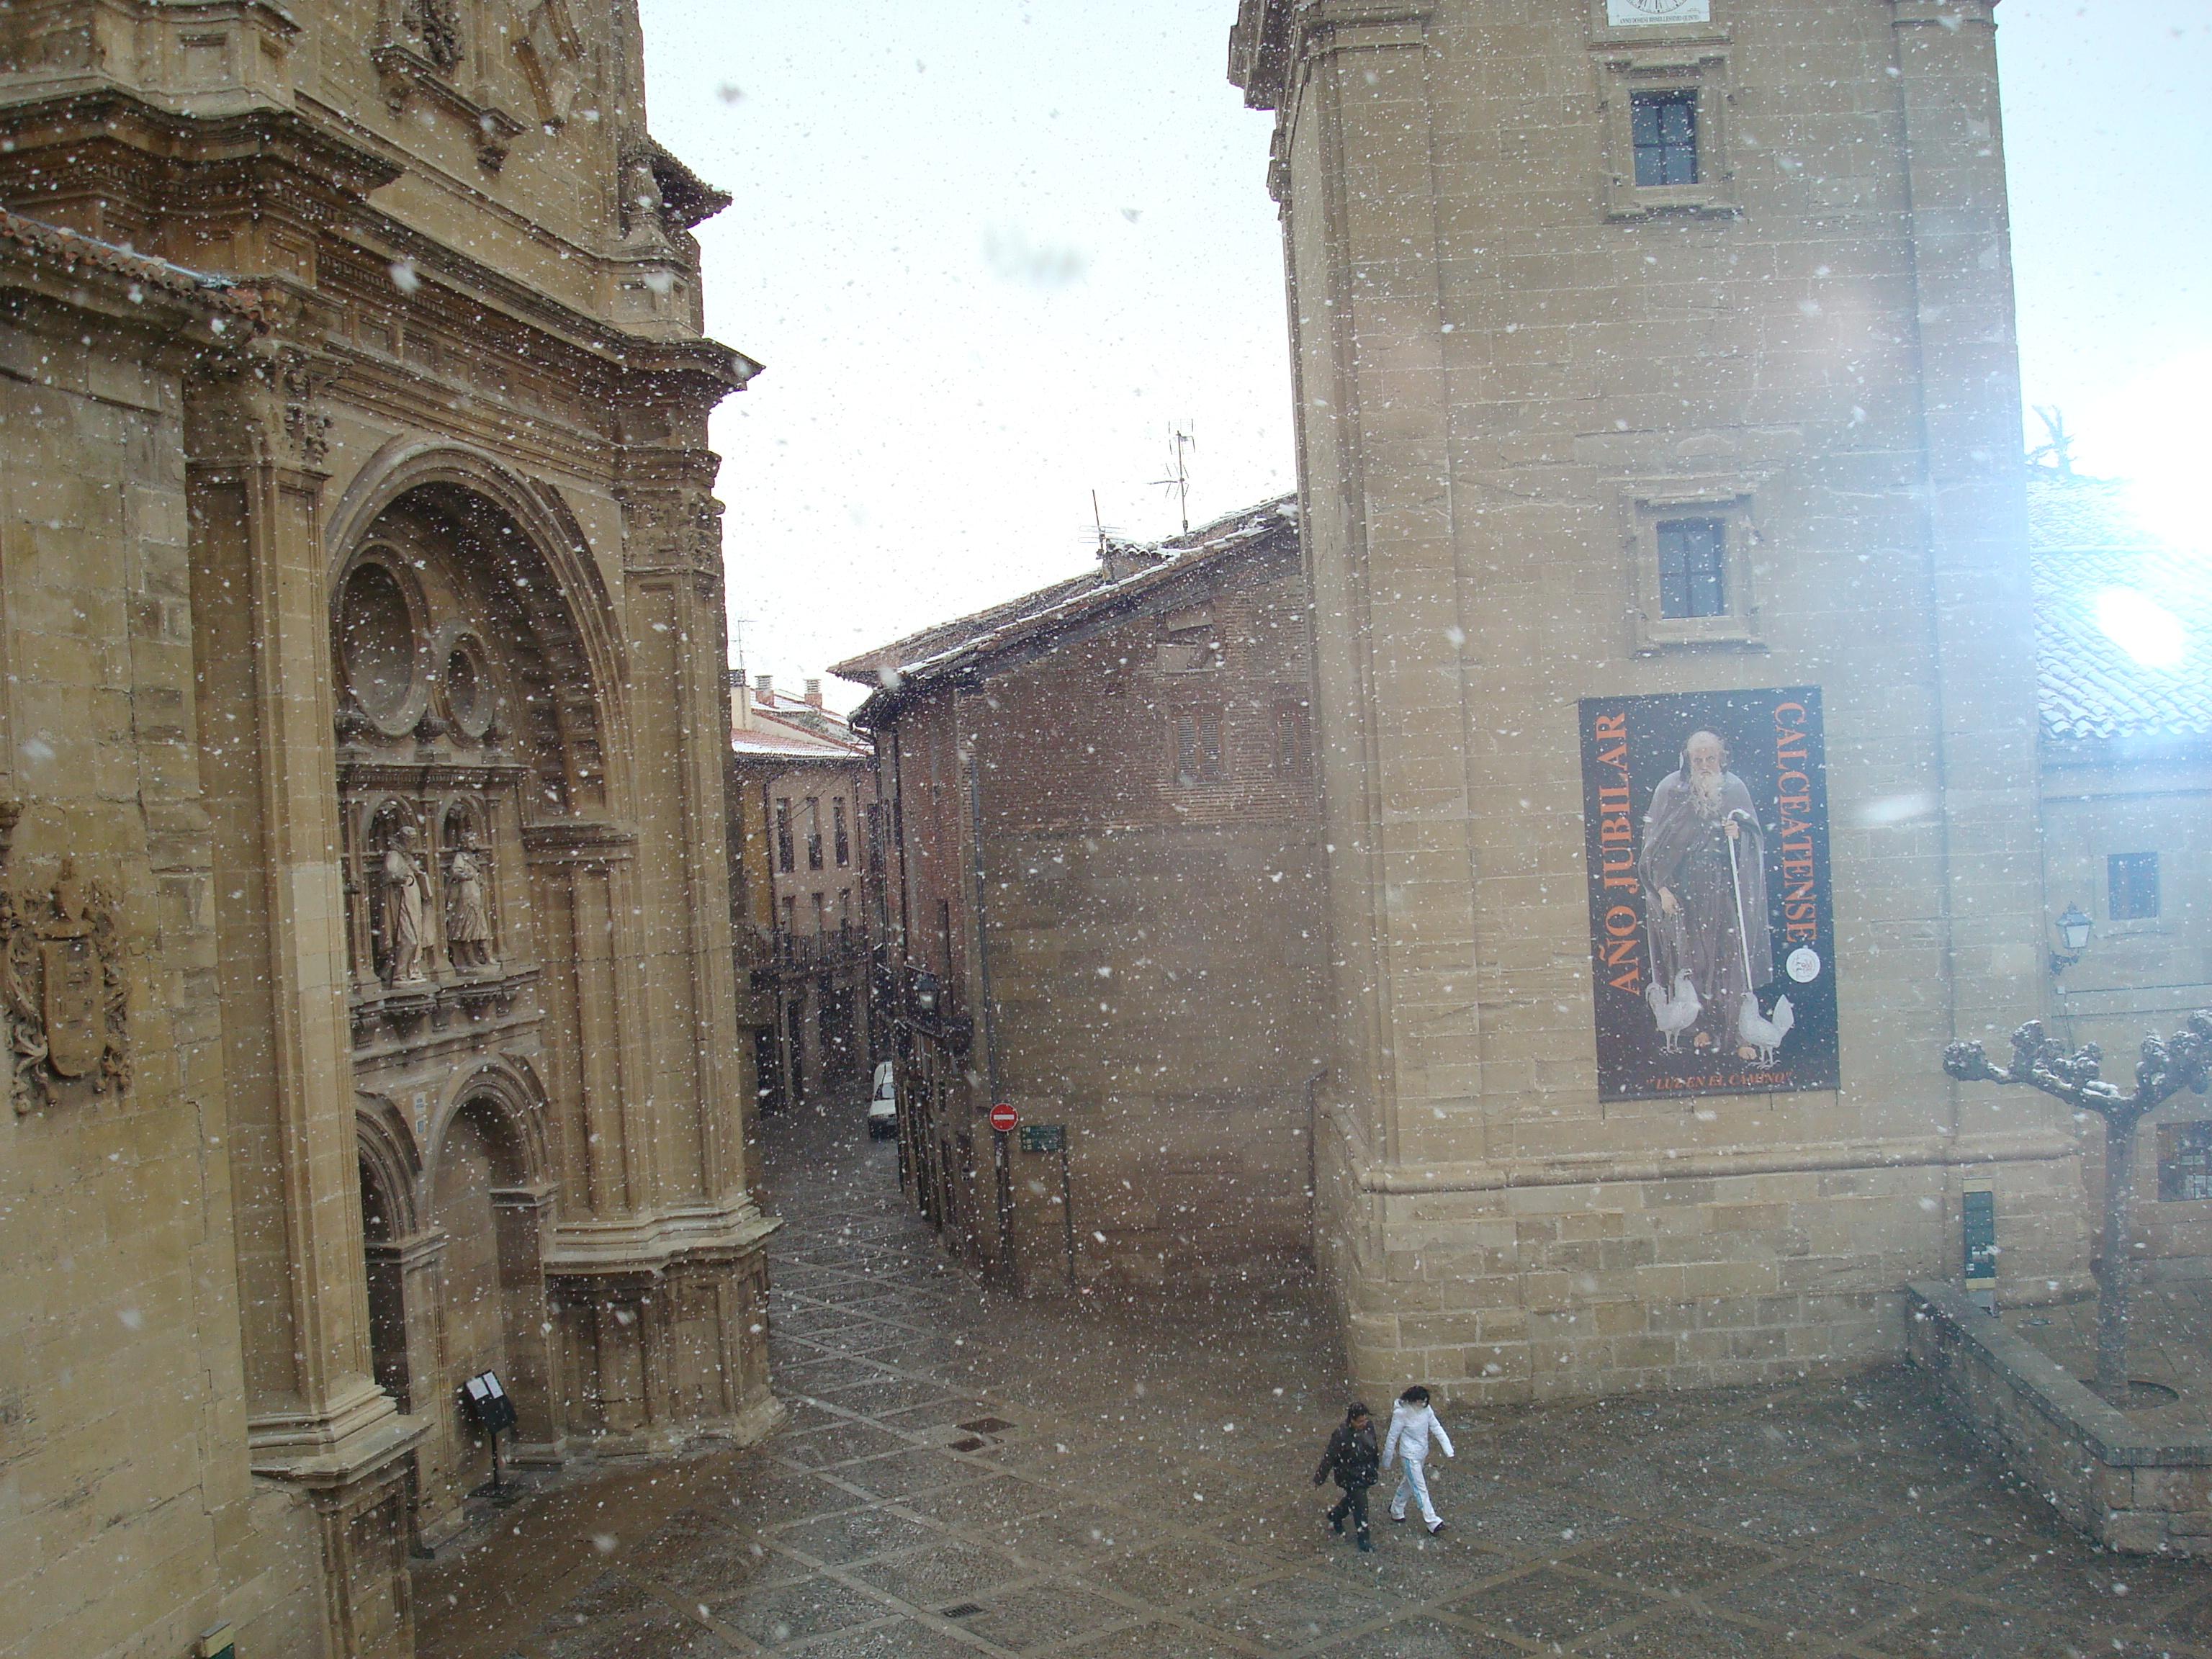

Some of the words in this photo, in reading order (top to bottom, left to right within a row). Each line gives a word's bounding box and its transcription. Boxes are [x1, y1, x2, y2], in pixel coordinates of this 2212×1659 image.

[1595, 711, 1638, 894] JUBILAR
[1773, 702, 1817, 943] CALCEATENSE
[1597, 905, 1641, 997] AÑO
[1686, 1076, 1704, 1088] EN
[1709, 1074, 1726, 1087] EL
